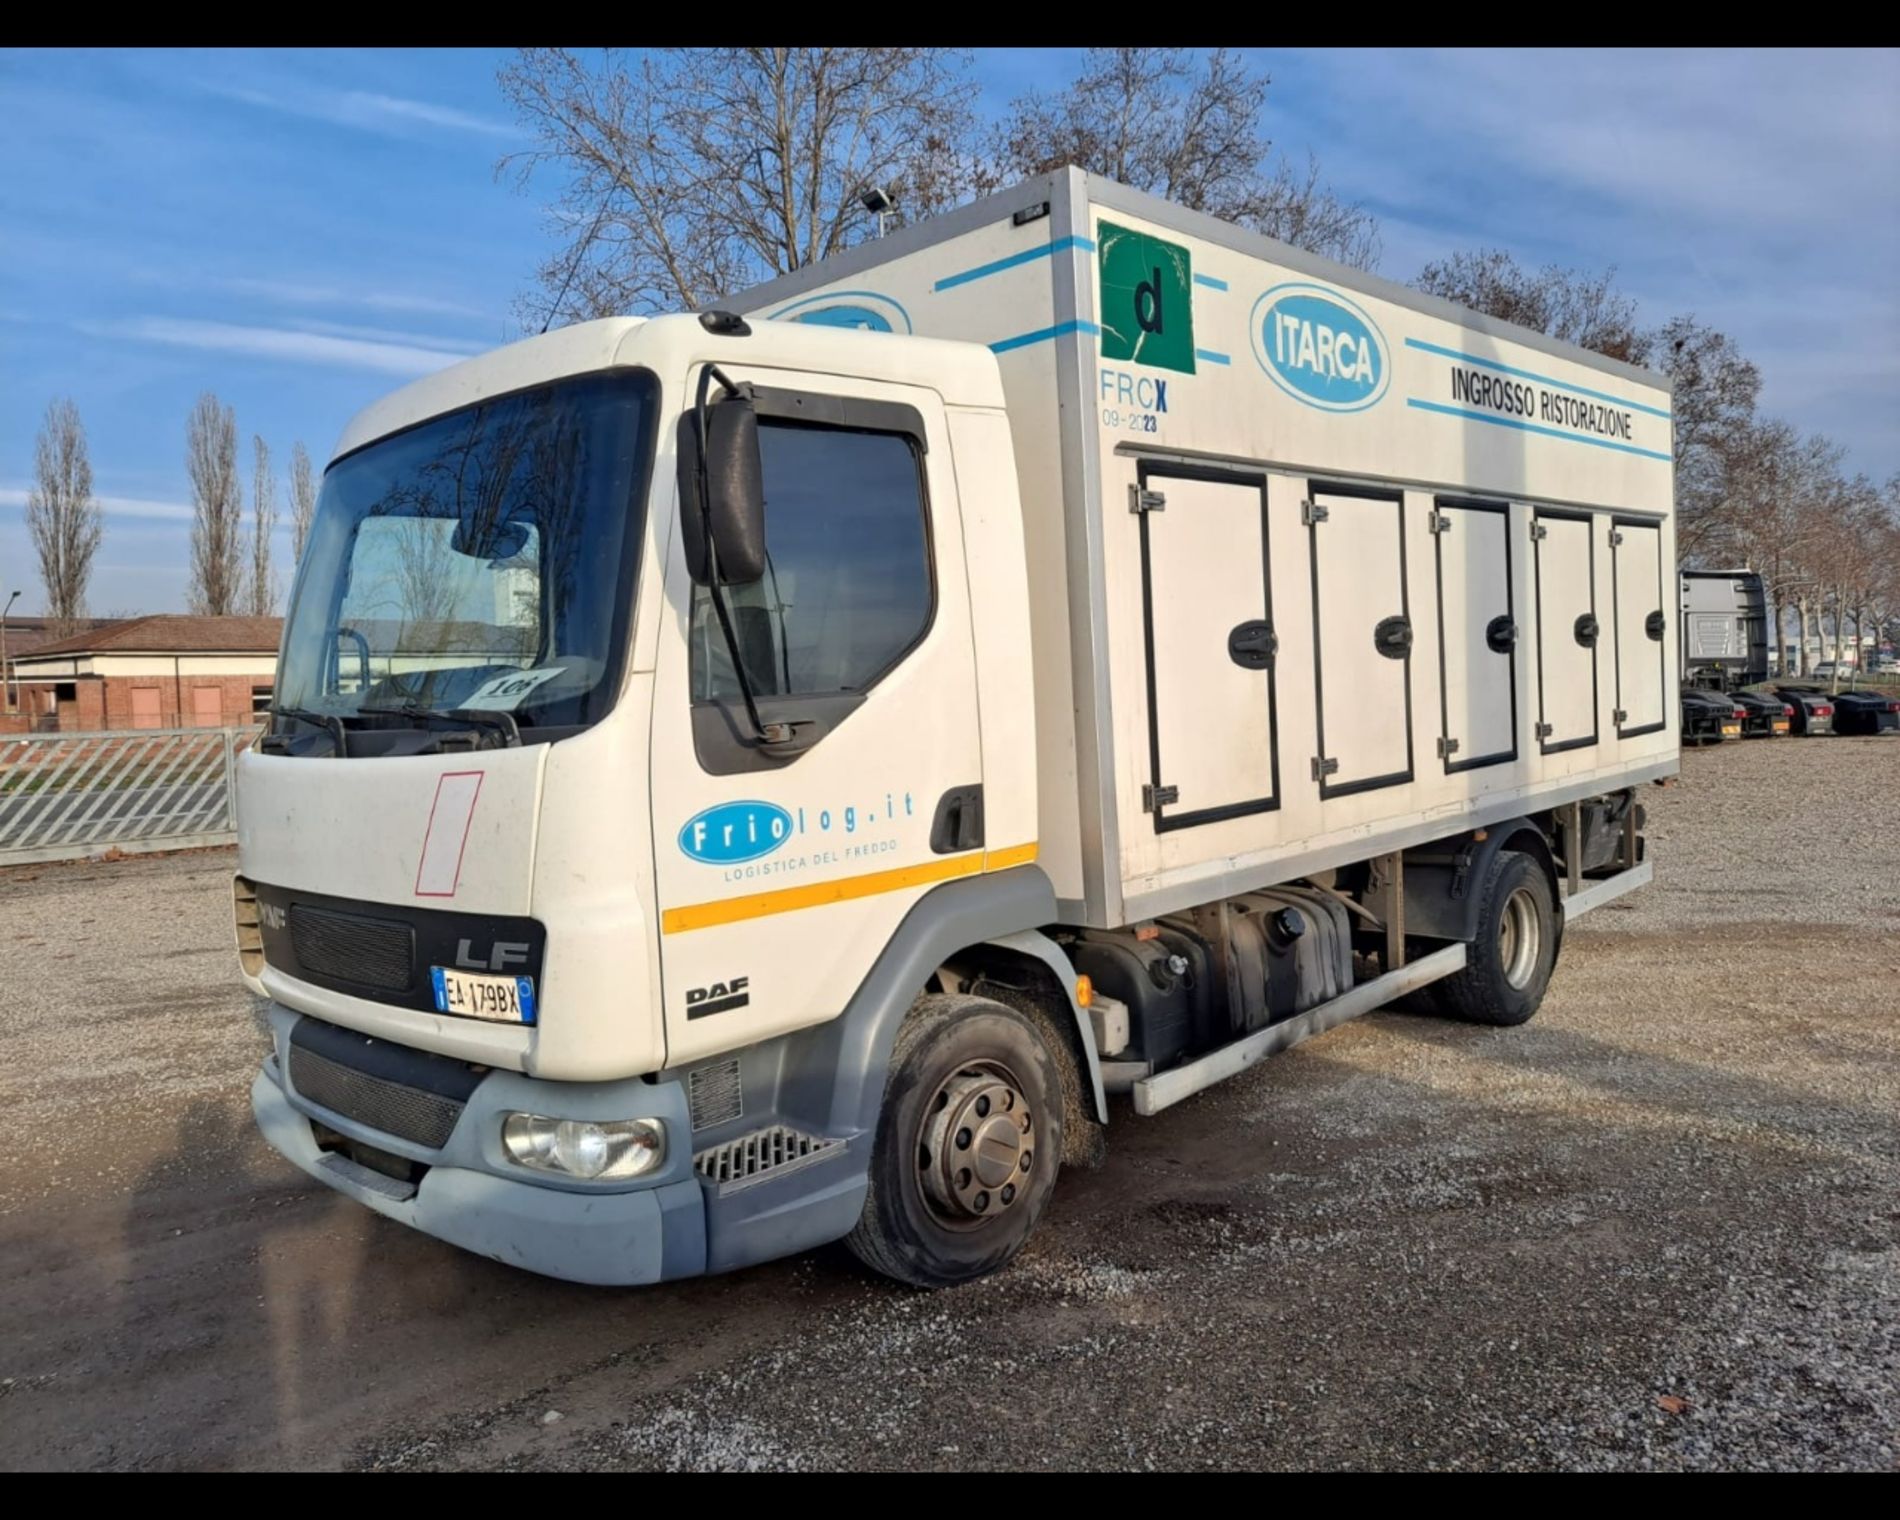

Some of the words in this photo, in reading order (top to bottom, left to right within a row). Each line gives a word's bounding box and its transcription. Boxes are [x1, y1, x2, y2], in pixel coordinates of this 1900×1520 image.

[1134, 266, 1163, 335] d
[1275, 312, 1374, 385] ITARCA
[1101, 369, 1168, 413] FRCX
[1452, 366, 1535, 418] INGROSSO
[1541, 391, 1632, 440] RISTORAZIONE
[724, 857, 806, 882] LOGISTICA
[813, 852, 839, 866] DEL
[845, 839, 897, 859] FREDDO
[456, 939, 530, 970] LF
[686, 976, 749, 1005] DAF
